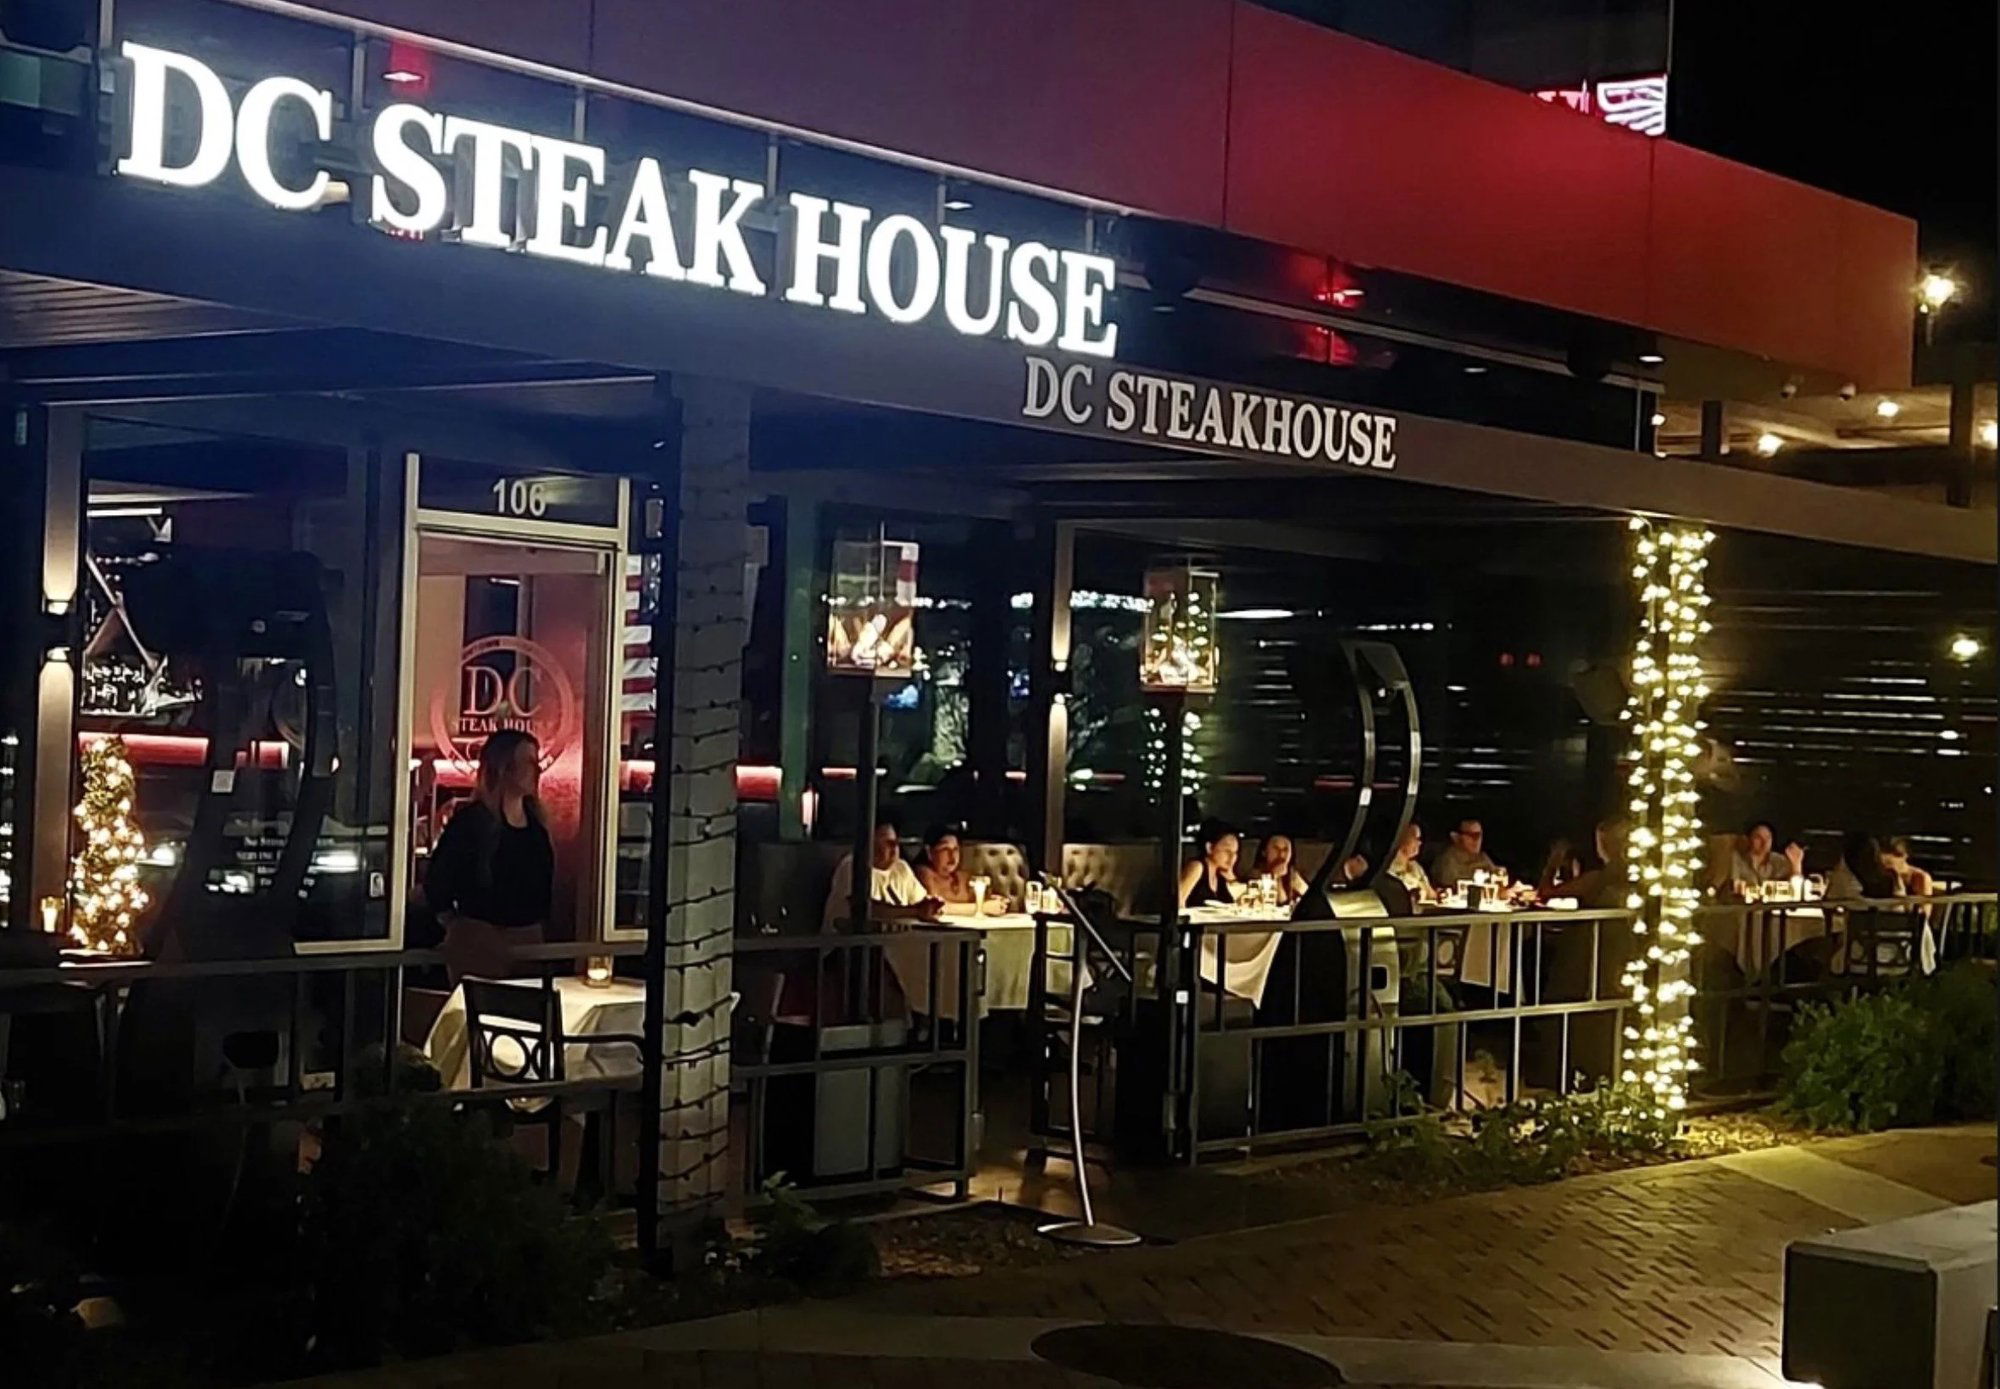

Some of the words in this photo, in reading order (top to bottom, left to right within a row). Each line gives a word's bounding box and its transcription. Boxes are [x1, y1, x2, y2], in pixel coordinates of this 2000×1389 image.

[117, 41, 332, 210] DC
[371, 103, 766, 295] STEAK
[786, 192, 1117, 358] HOUSE
[1022, 357, 1093, 424] DC
[1106, 371, 1397, 469] STEAKHOUSE
[493, 478, 546, 517] 106
[463, 665, 542, 717] DC
